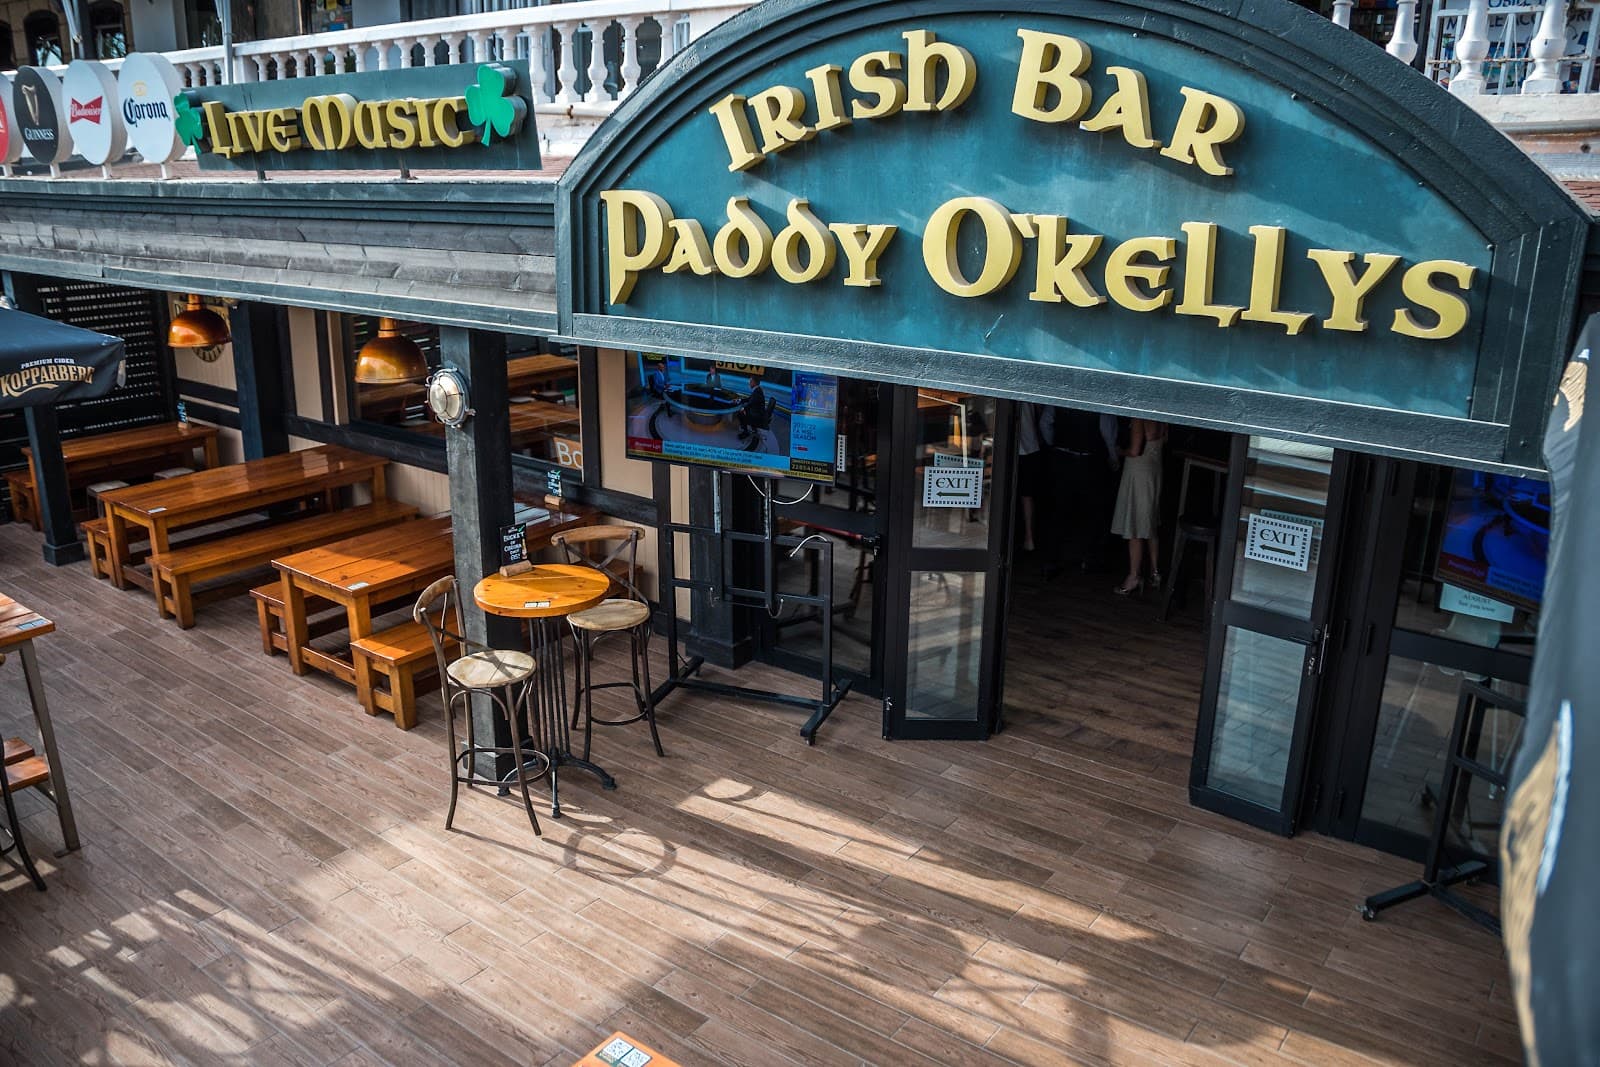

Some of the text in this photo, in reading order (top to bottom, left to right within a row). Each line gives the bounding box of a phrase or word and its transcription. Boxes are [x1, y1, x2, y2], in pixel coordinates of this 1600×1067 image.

[123, 97, 170, 127] Corona
[709, 28, 1246, 178] IRISH BAR
[25, 128, 54, 140] GUINNESS
[203, 93, 475, 158] LIVE MUSIC
[600, 190, 898, 305] PADDY
[21, 358, 52, 369] PREMIUM
[0, 364, 95, 397] KOPPARBERG
[936, 477, 971, 489] EXIT
[1260, 528, 1300, 546] EXIT
